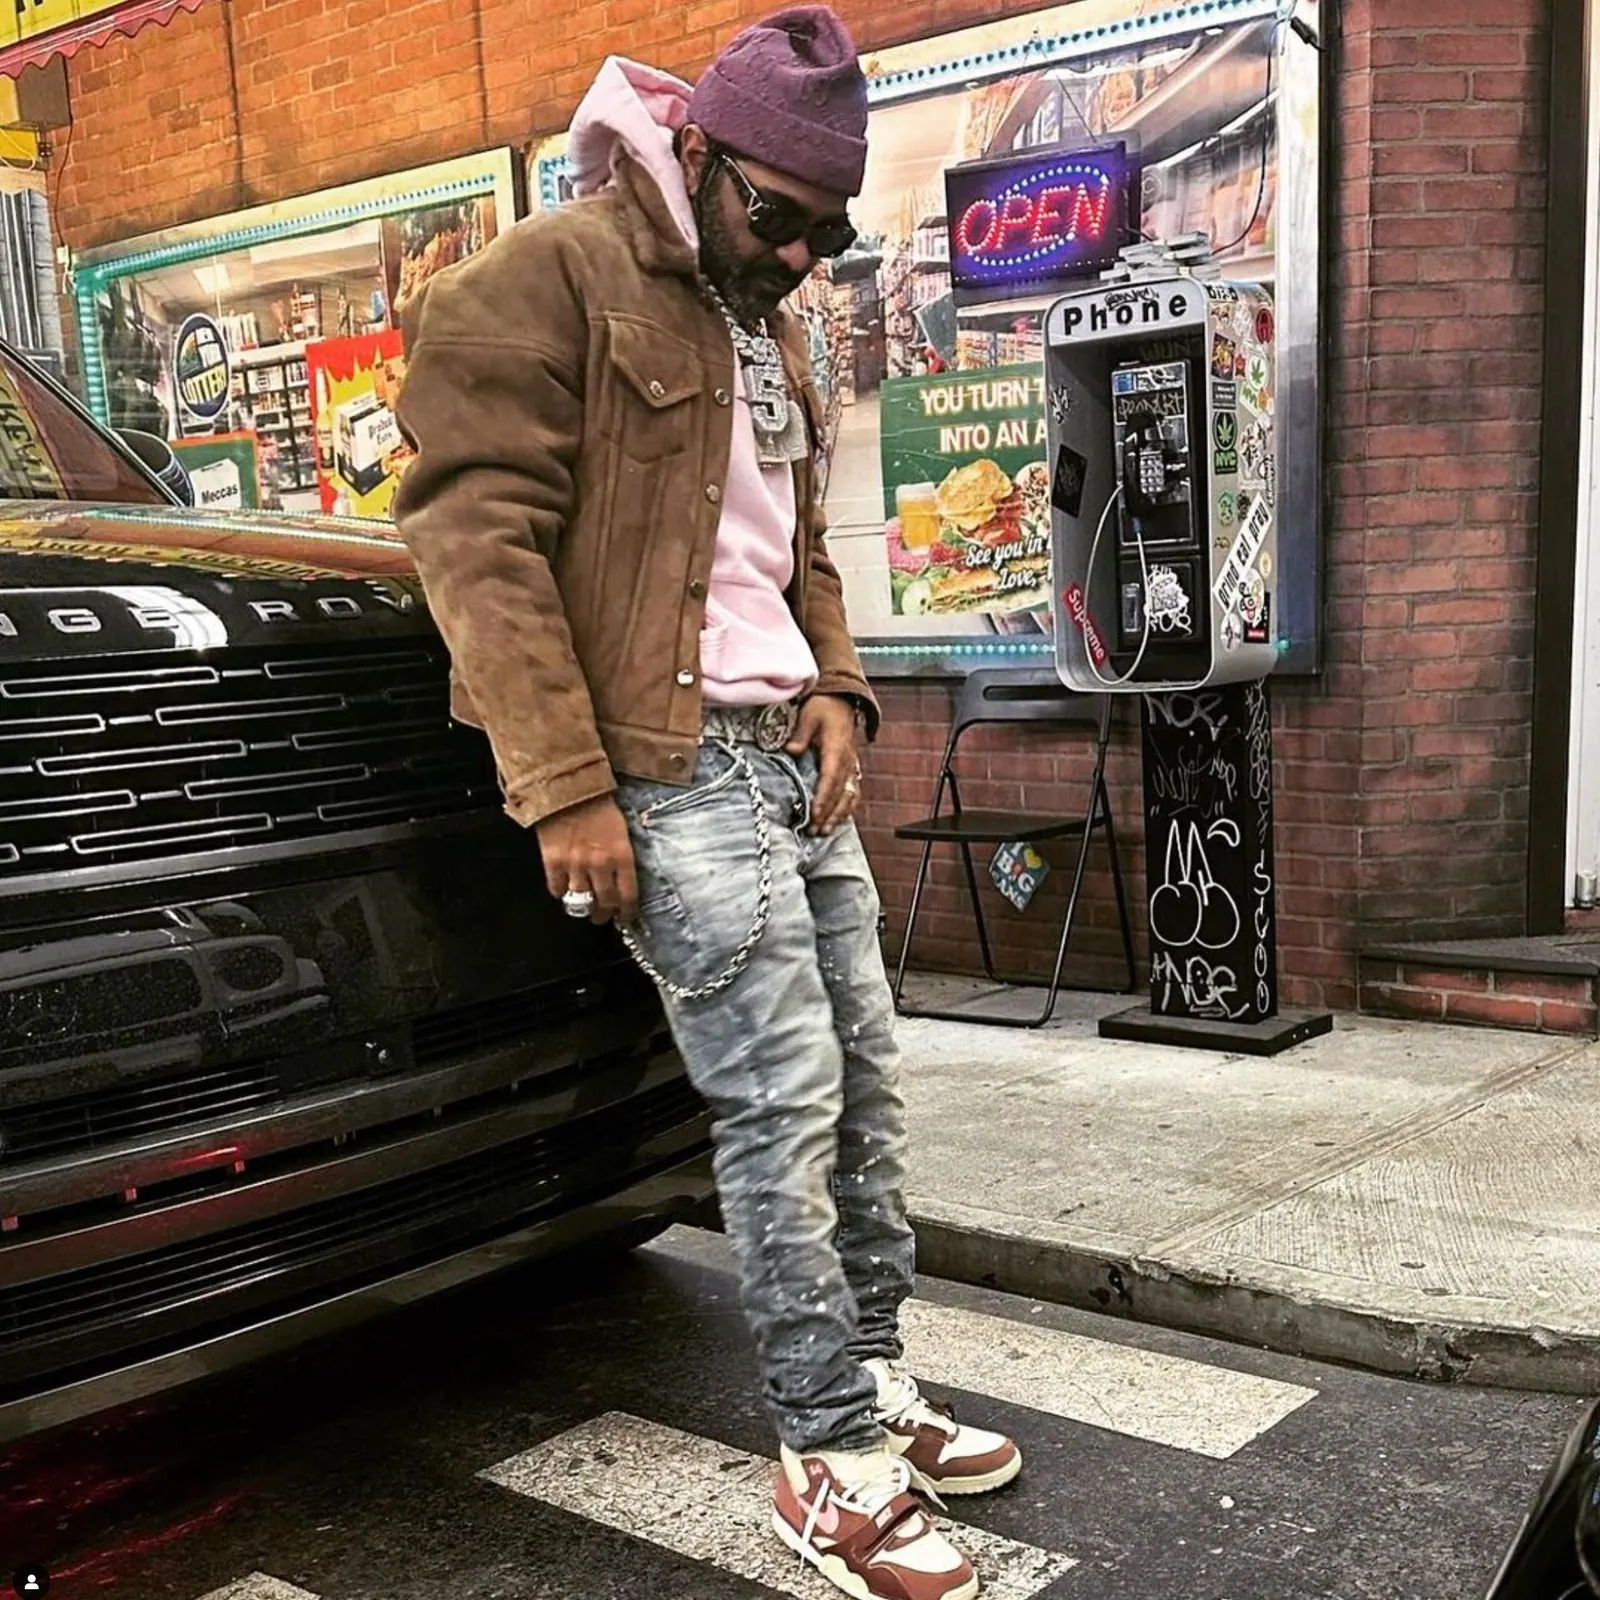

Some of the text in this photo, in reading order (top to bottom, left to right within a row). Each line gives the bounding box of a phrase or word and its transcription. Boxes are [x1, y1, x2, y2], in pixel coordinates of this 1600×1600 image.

[956, 184, 1108, 250] OPEN
[1063, 294, 1188, 336] Phone
[919, 386, 965, 416] YOU
[967, 379, 1029, 412] TURN
[939, 424, 990, 454] INTO
[995, 419, 1029, 449] AN
[1215, 451, 1237, 468] NYC
[201, 483, 239, 505] Meccas
[965, 544, 991, 569] See
[992, 539, 1024, 571] you
[1027, 532, 1042, 554] in
[997, 567, 1037, 590] Love,
